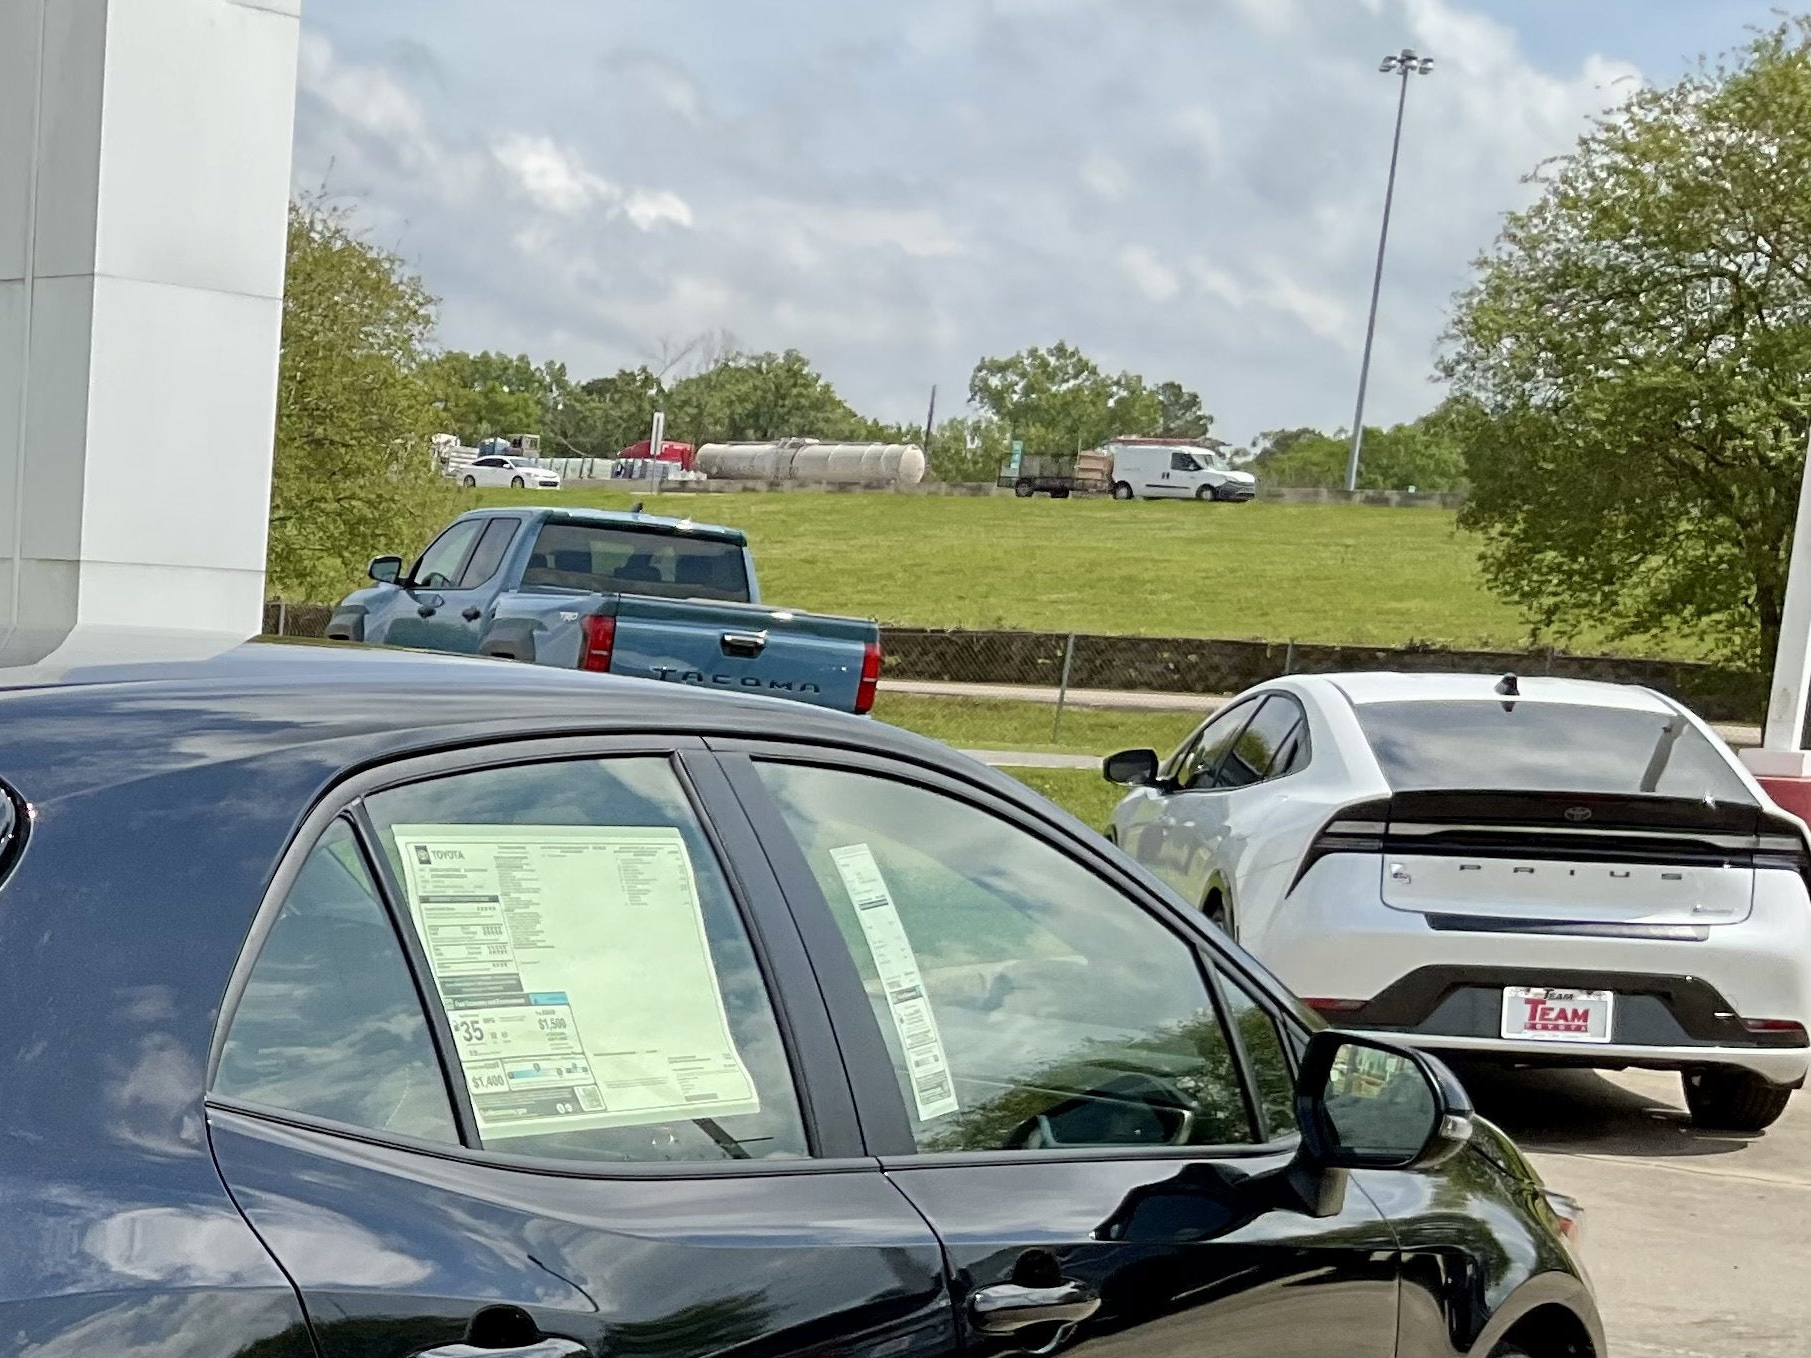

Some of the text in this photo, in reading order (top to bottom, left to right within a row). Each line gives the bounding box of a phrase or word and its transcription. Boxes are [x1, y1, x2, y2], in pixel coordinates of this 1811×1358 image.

[651, 667, 821, 693] TACOMA
[431, 850, 465, 860] TOYOTA
[1459, 864, 1683, 881] PRIUS
[1524, 998, 1590, 1022] TEAM
[459, 1020, 484, 1042] 35
